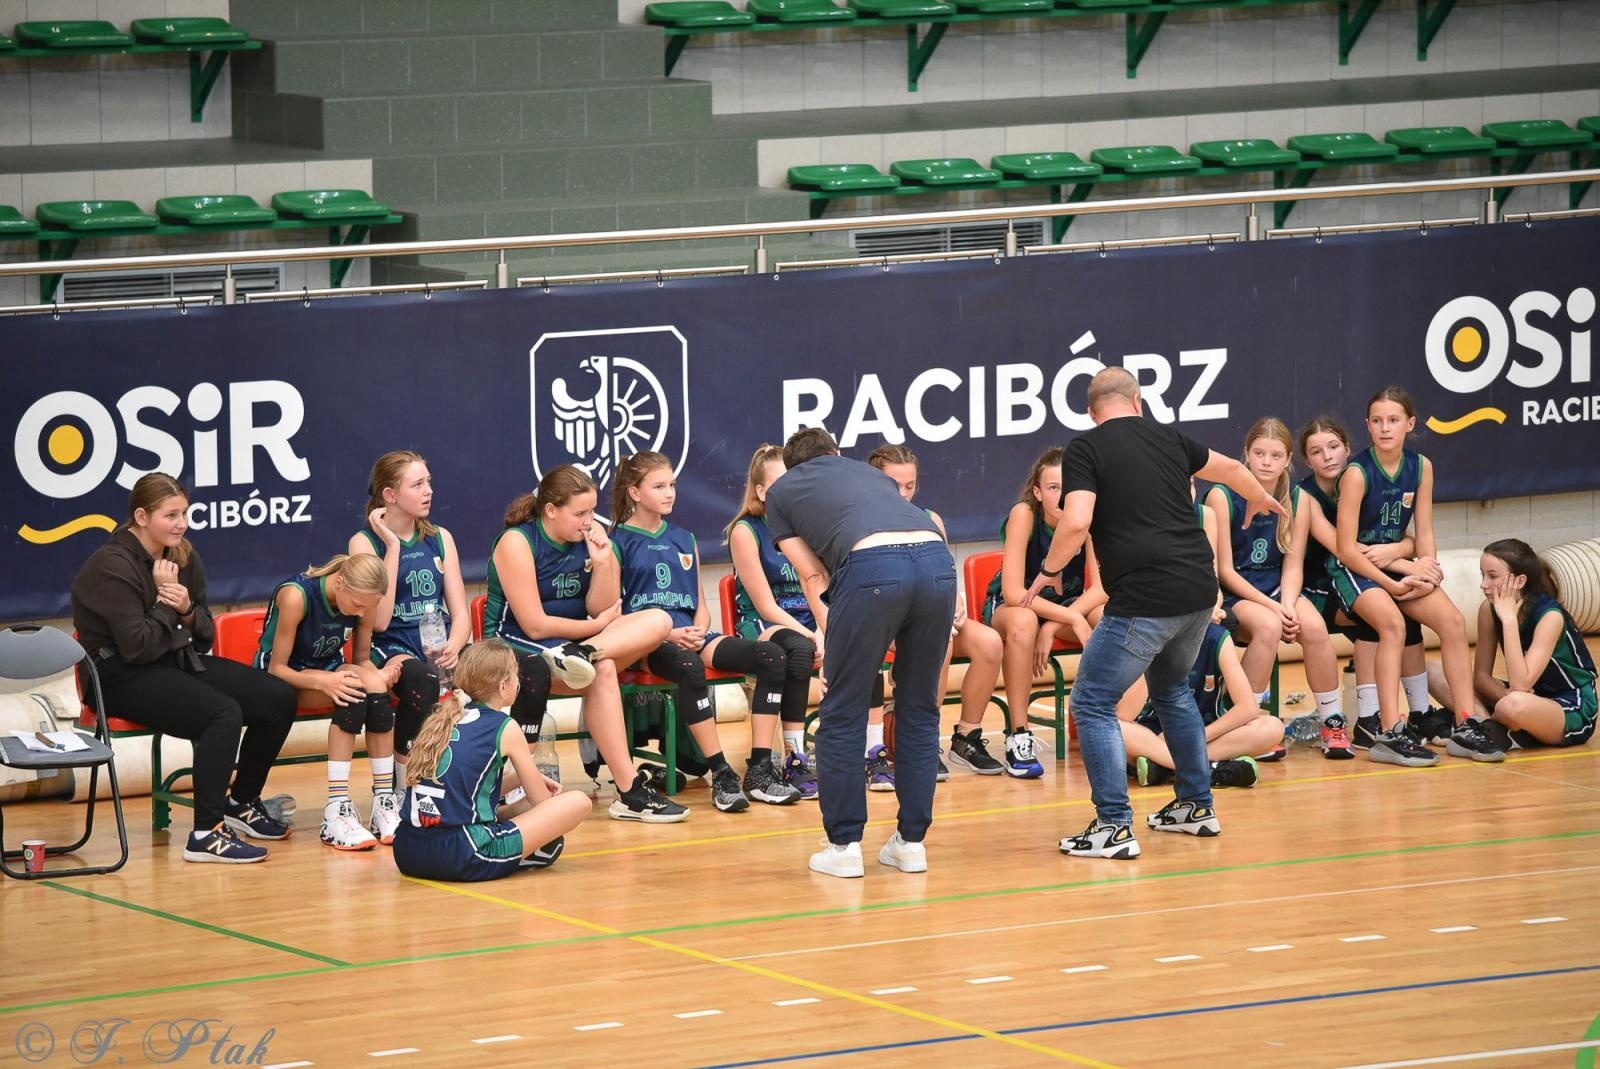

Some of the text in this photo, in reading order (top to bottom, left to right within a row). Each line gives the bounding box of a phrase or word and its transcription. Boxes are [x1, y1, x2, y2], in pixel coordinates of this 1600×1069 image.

[782, 330, 1229, 448] RACIBÓRZ
[14, 380, 311, 499] OSiR
[187, 489, 312, 531] CIBÓRZ
[1380, 500, 1402, 526] 14
[1251, 538, 1268, 563] 8
[406, 569, 437, 598] 18
[552, 572, 581, 599] 15
[655, 562, 671, 589] 9
[630, 591, 695, 609] OLIMPIA
[313, 636, 341, 658] 12
